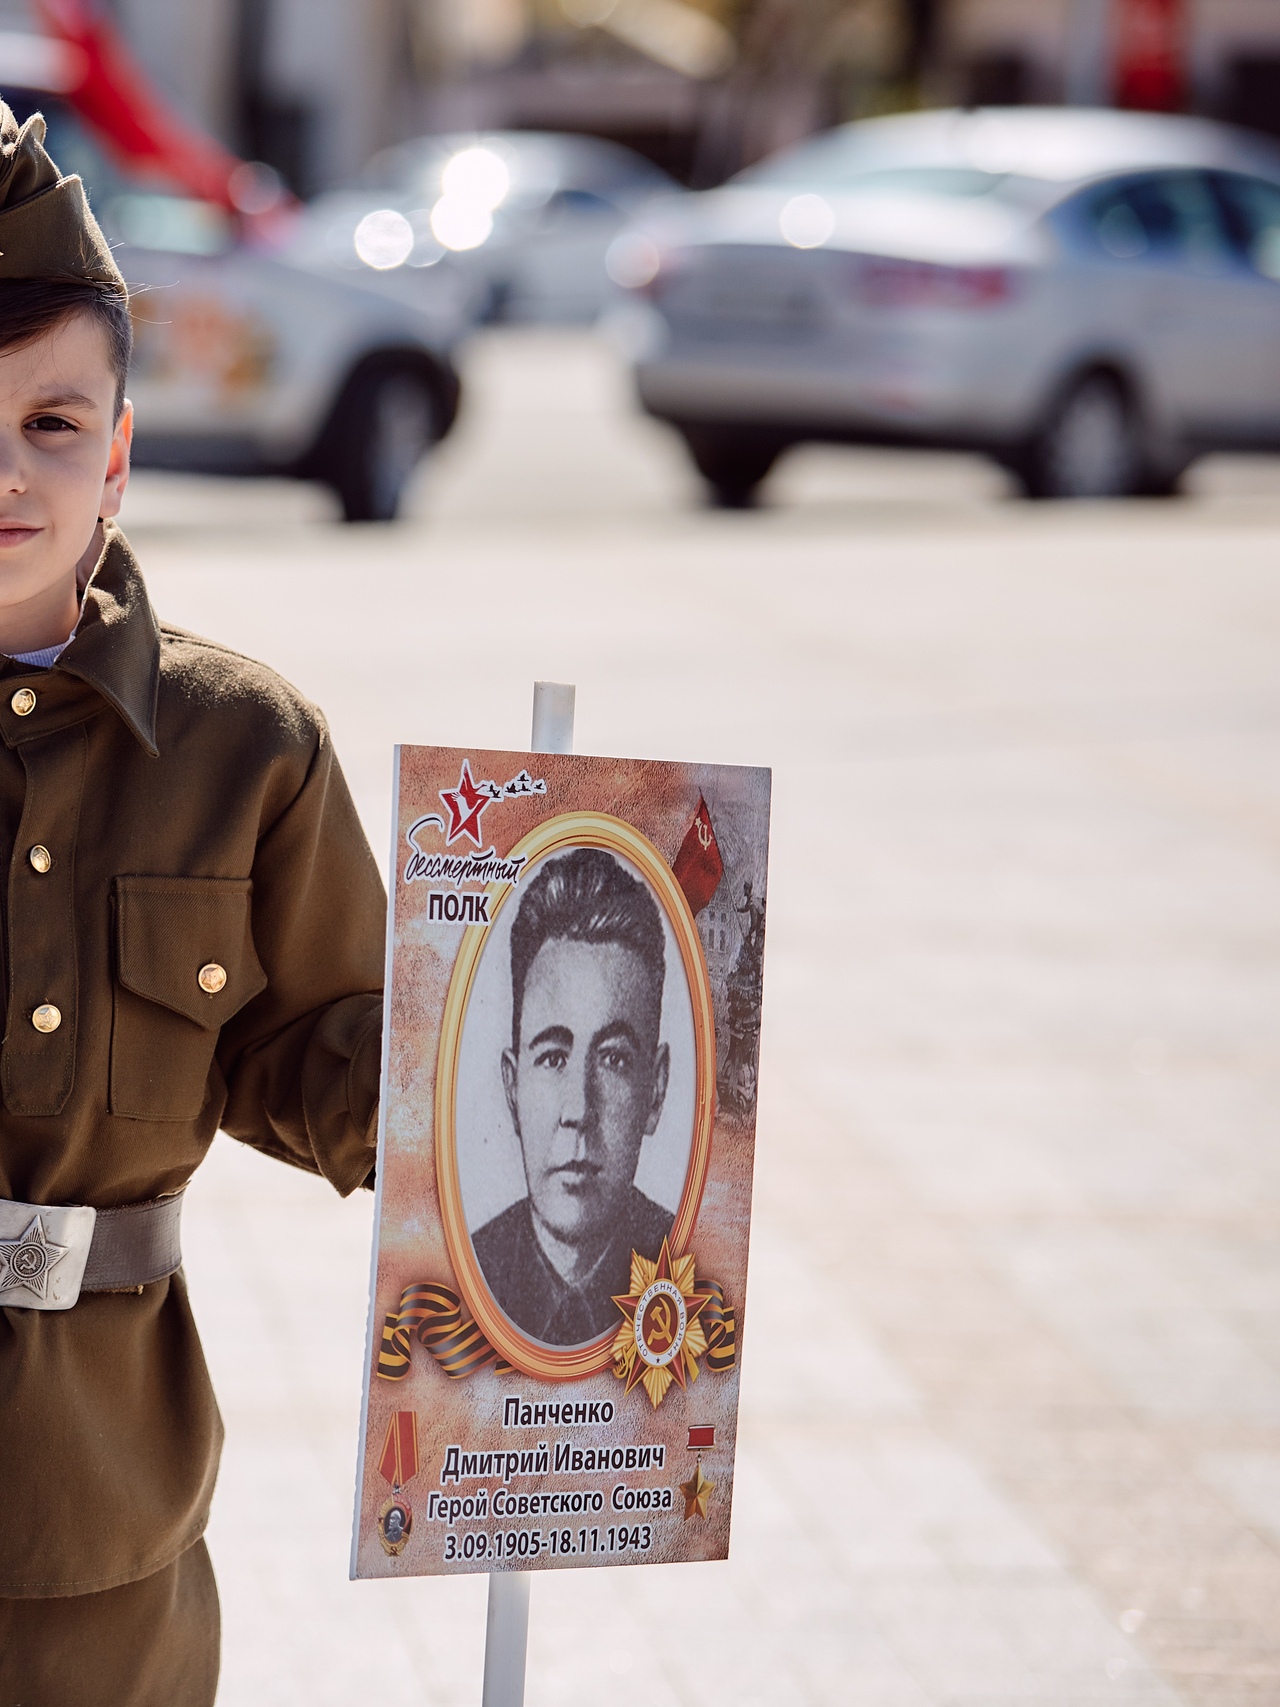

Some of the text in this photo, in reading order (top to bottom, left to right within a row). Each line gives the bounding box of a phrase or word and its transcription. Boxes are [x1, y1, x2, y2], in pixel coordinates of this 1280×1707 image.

[428, 893, 489, 922] ПОЛК
[635, 1283, 683, 1357] ОТЕЧЕСТВЕННАЯ
[504, 1398, 614, 1427] Панченко
[442, 1444, 665, 1482] Дмитрий Иванович
[428, 1492, 487, 1524] Герой
[492, 1490, 603, 1516] Советского
[613, 1486, 672, 1510] Союза
[444, 1525, 652, 1560] 3.09.1905-18.11.1943
